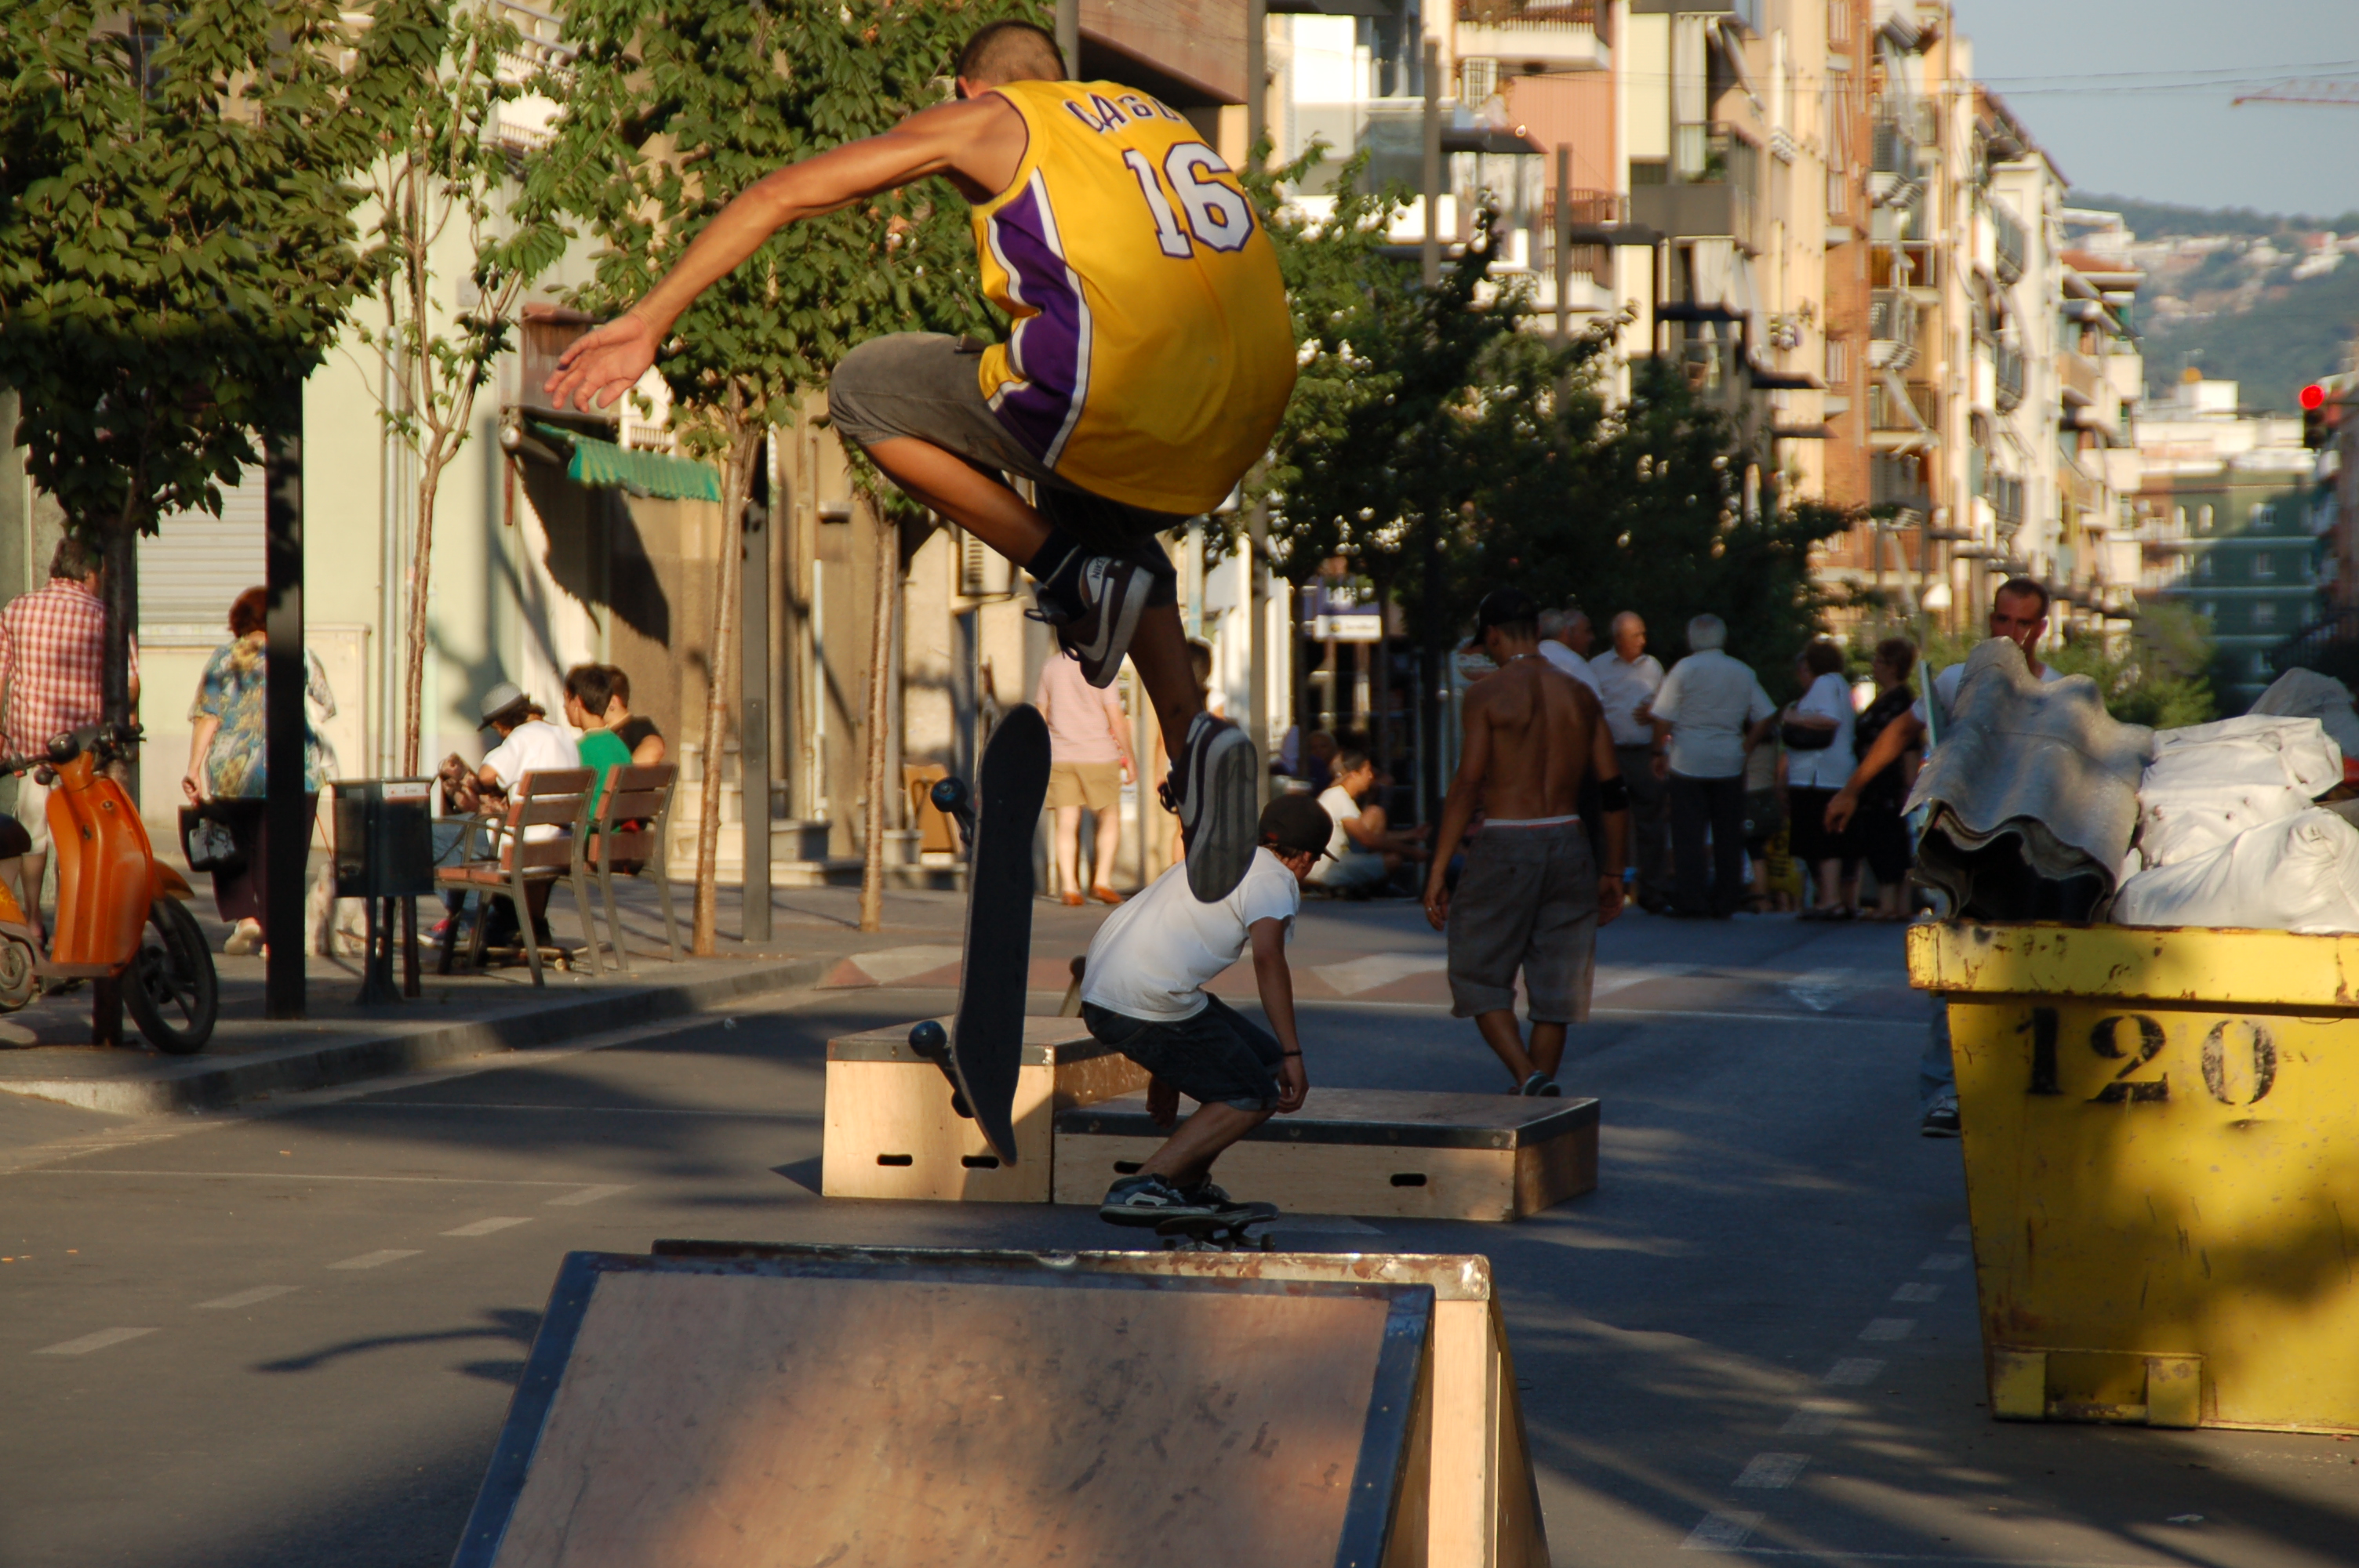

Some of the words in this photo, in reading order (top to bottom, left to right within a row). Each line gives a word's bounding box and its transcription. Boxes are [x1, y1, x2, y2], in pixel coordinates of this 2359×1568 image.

[1121, 141, 1255, 259] 16
[1091, 557, 1106, 579] NIKE
[2016, 1007, 2277, 1106] 120
